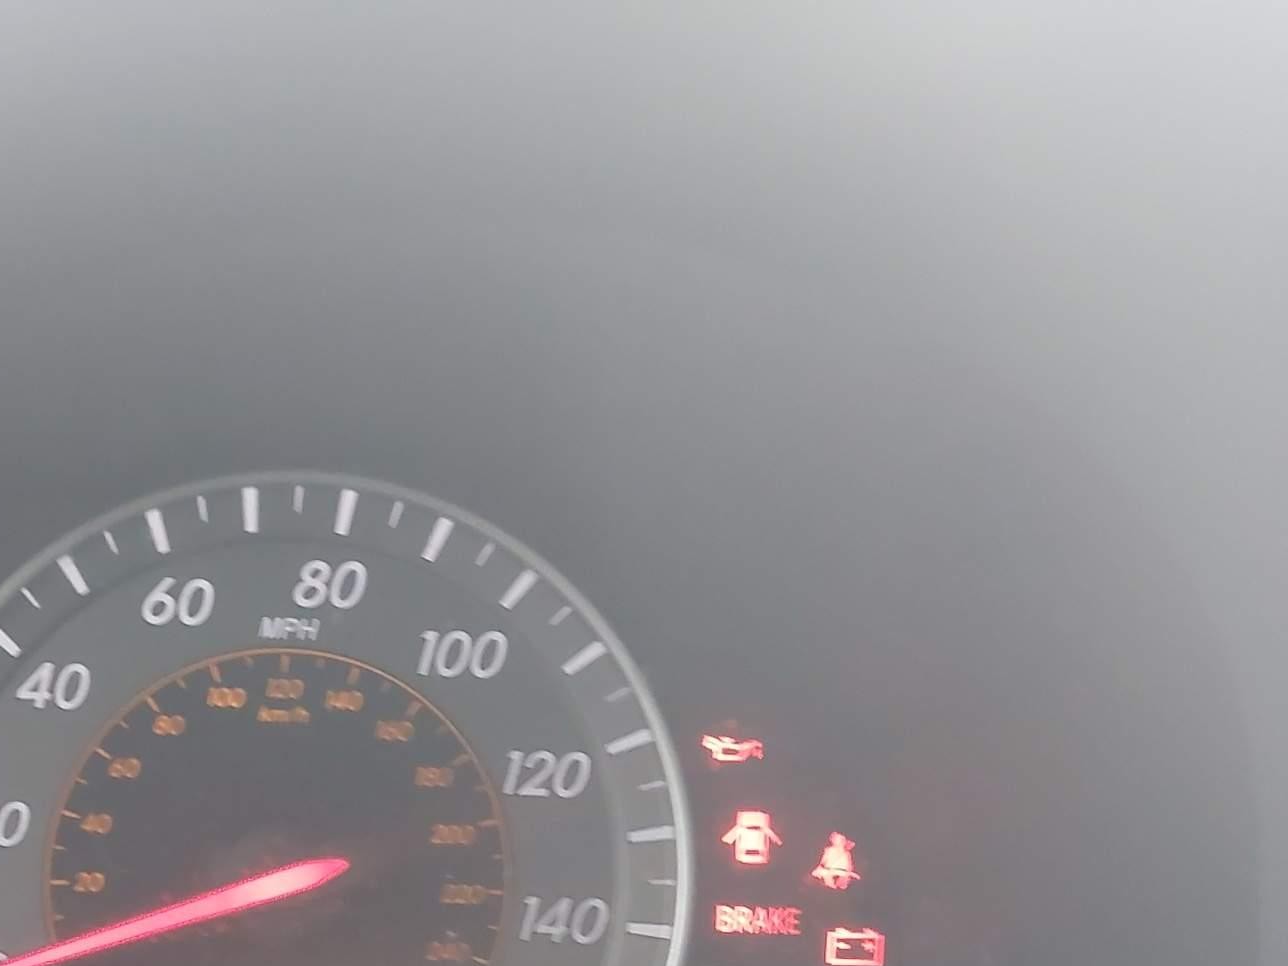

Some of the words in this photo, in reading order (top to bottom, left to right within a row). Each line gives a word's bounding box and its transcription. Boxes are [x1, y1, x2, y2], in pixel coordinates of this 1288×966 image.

[140, 576, 216, 627] 60
[291, 559, 368, 611] 80
[258, 616, 321, 641] MPH
[415, 629, 508, 680] 100
[15, 661, 92, 711] 40
[501, 750, 592, 799] 120
[518, 896, 611, 946] 140
[714, 904, 803, 935] BRAKE
